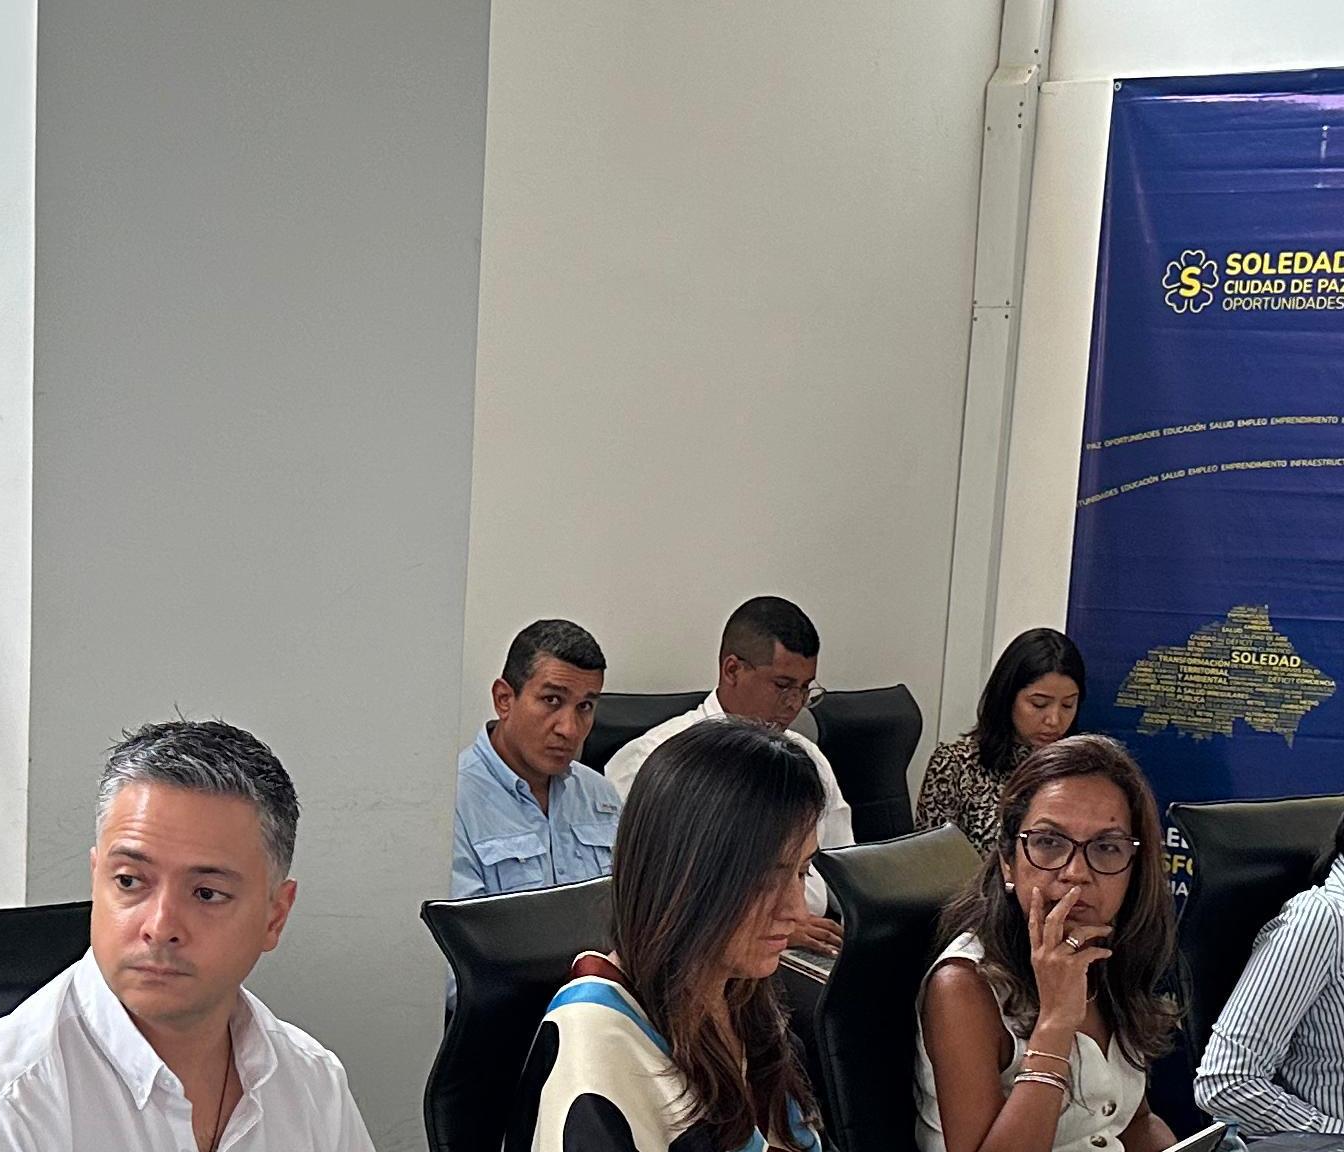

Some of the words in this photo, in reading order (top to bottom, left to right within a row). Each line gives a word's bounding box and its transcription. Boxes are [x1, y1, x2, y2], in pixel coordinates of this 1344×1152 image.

[1223, 279, 1286, 295] CIUDAD
[1290, 279, 1313, 294] DE
[1162, 423, 1207, 436] EDUCACIÓN
[1209, 420, 1235, 430] SALUD
[1237, 417, 1268, 428] EMPLEO
[1270, 416, 1338, 426] EMPRENDIMIENTO
[1120, 475, 1159, 492] EDUCACIÓN
[1160, 469, 1186, 481] SALUD
[1188, 464, 1218, 476] EMPLEO
[1220, 459, 1288, 471] EMPRENDIMIENTO
[1231, 651, 1301, 668] SOLEDAD
